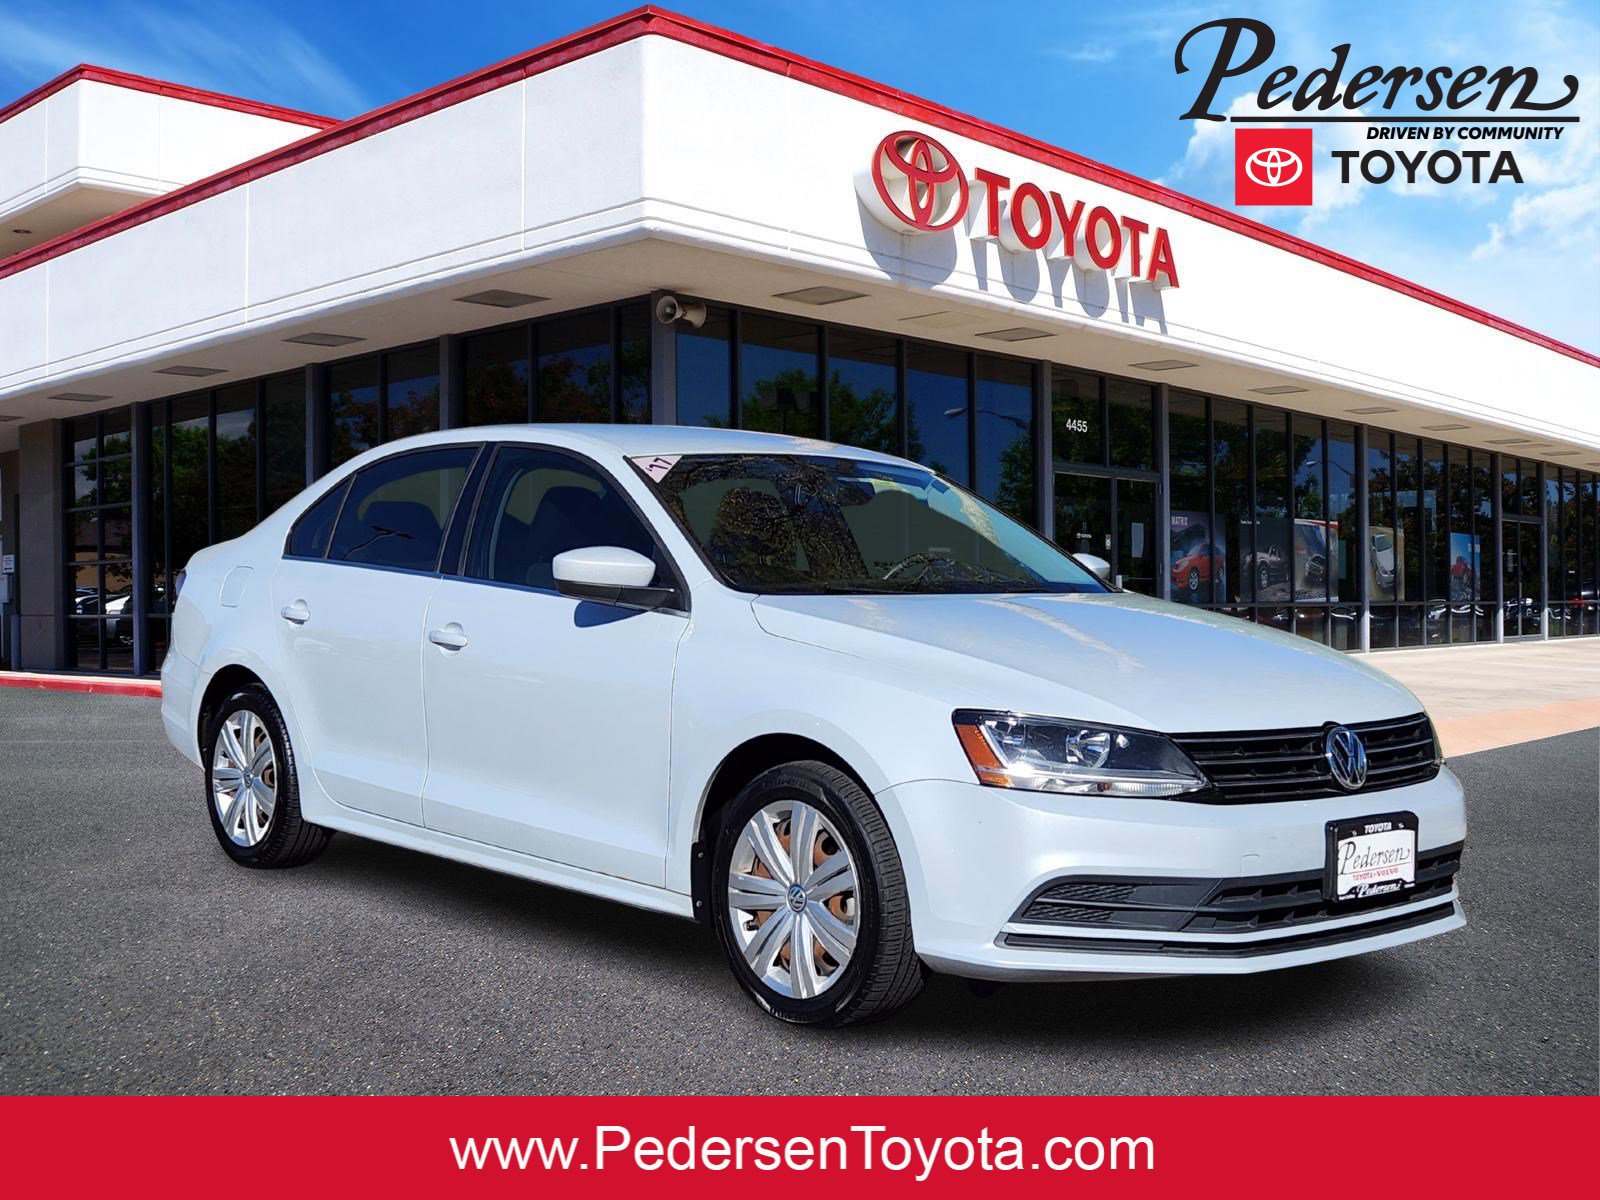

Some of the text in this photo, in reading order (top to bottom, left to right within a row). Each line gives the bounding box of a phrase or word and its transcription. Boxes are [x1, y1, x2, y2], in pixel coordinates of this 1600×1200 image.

[974, 167, 1180, 288] TOYOTA
[1065, 418, 1088, 433] 4455
[1364, 821, 1393, 835] TOYOTA
[1338, 841, 1410, 875] Pedersen
